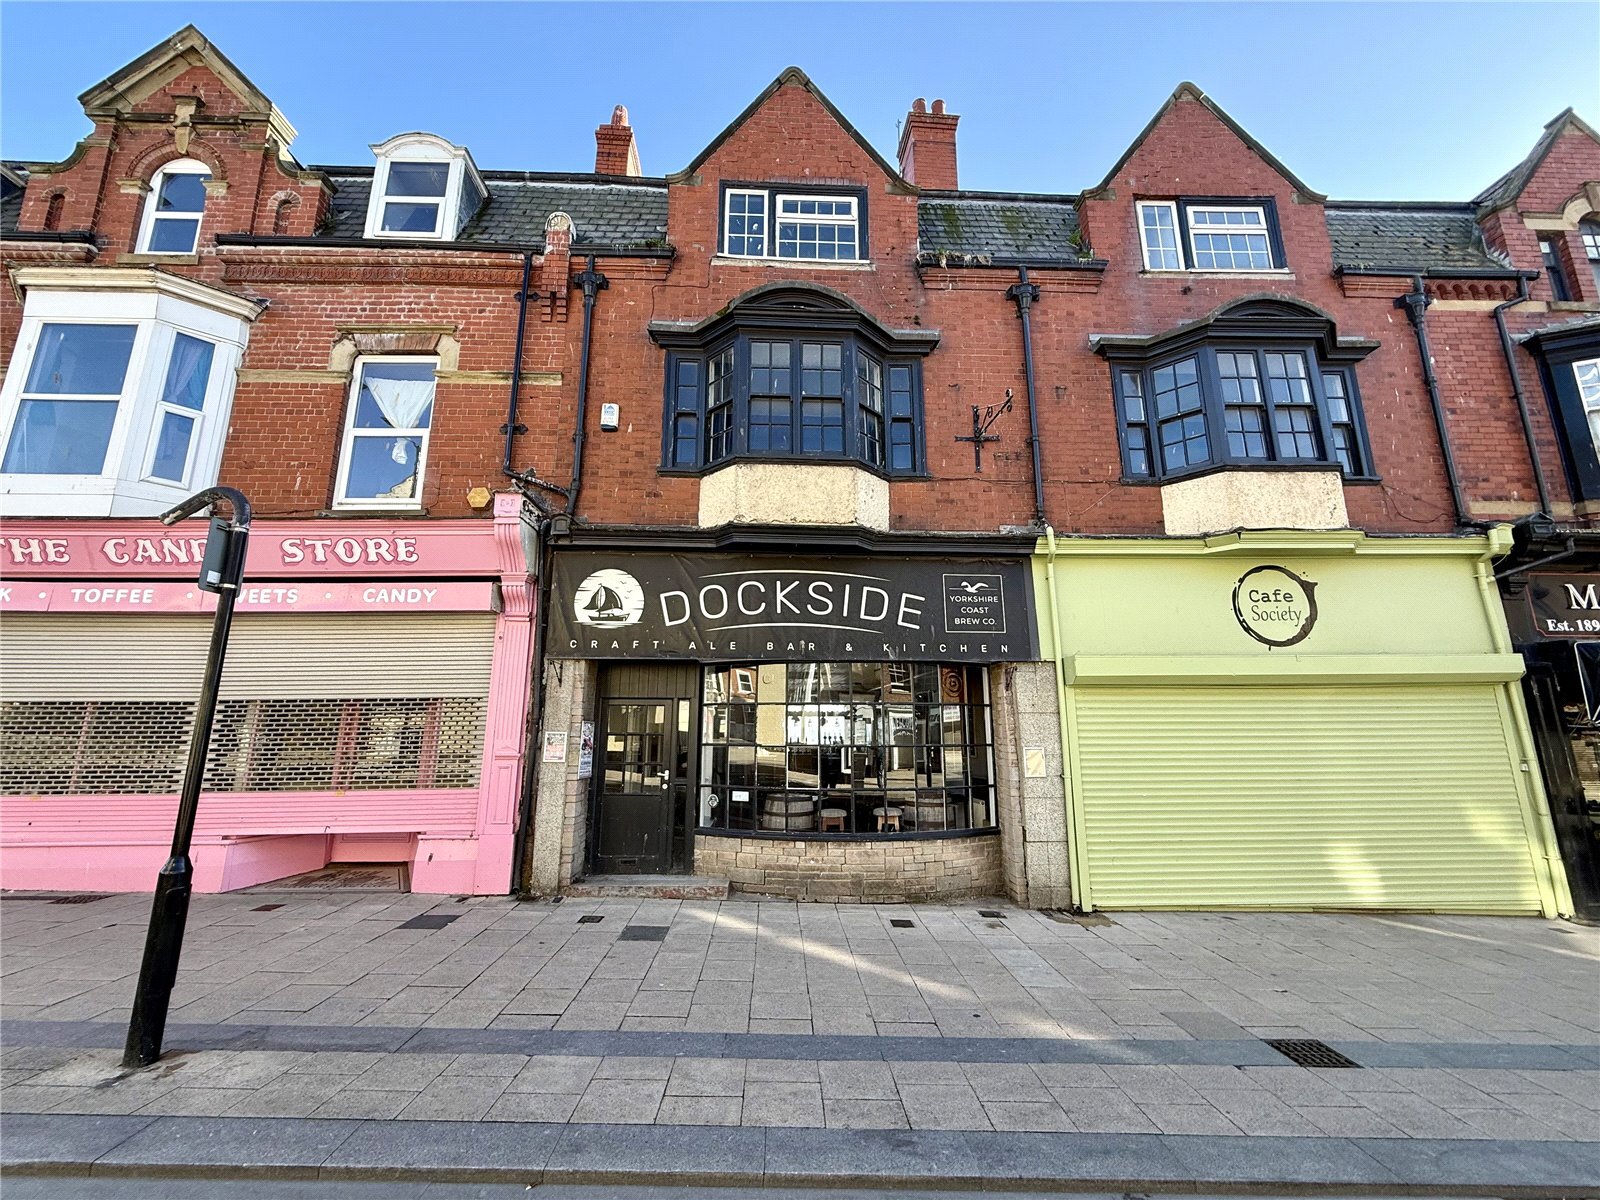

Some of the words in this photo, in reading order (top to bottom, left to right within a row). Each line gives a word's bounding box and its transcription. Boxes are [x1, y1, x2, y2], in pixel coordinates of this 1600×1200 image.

[0, 537, 70, 564] HE
[101, 537, 207, 564] CAND
[281, 537, 419, 564] STORE
[71, 588, 154, 604] TOFFEE
[236, 588, 299, 604] EETS
[362, 588, 438, 604] CANDY
[949, 595, 999, 603] YORKSHIRE
[1248, 588, 1294, 603] Cafe
[660, 581, 925, 629] DOCKSIDE
[960, 606, 989, 614] COAST
[954, 617, 980, 625] BREW
[982, 617, 998, 625] CO.
[1251, 604, 1302, 627] Society
[1546, 619, 1575, 632] Est.
[569, 639, 660, 650] CRAFT
[689, 640, 737, 651] ALE
[766, 641, 816, 652] BAR
[845, 642, 853, 652] &
[883, 643, 1009, 654] KITCHEN
